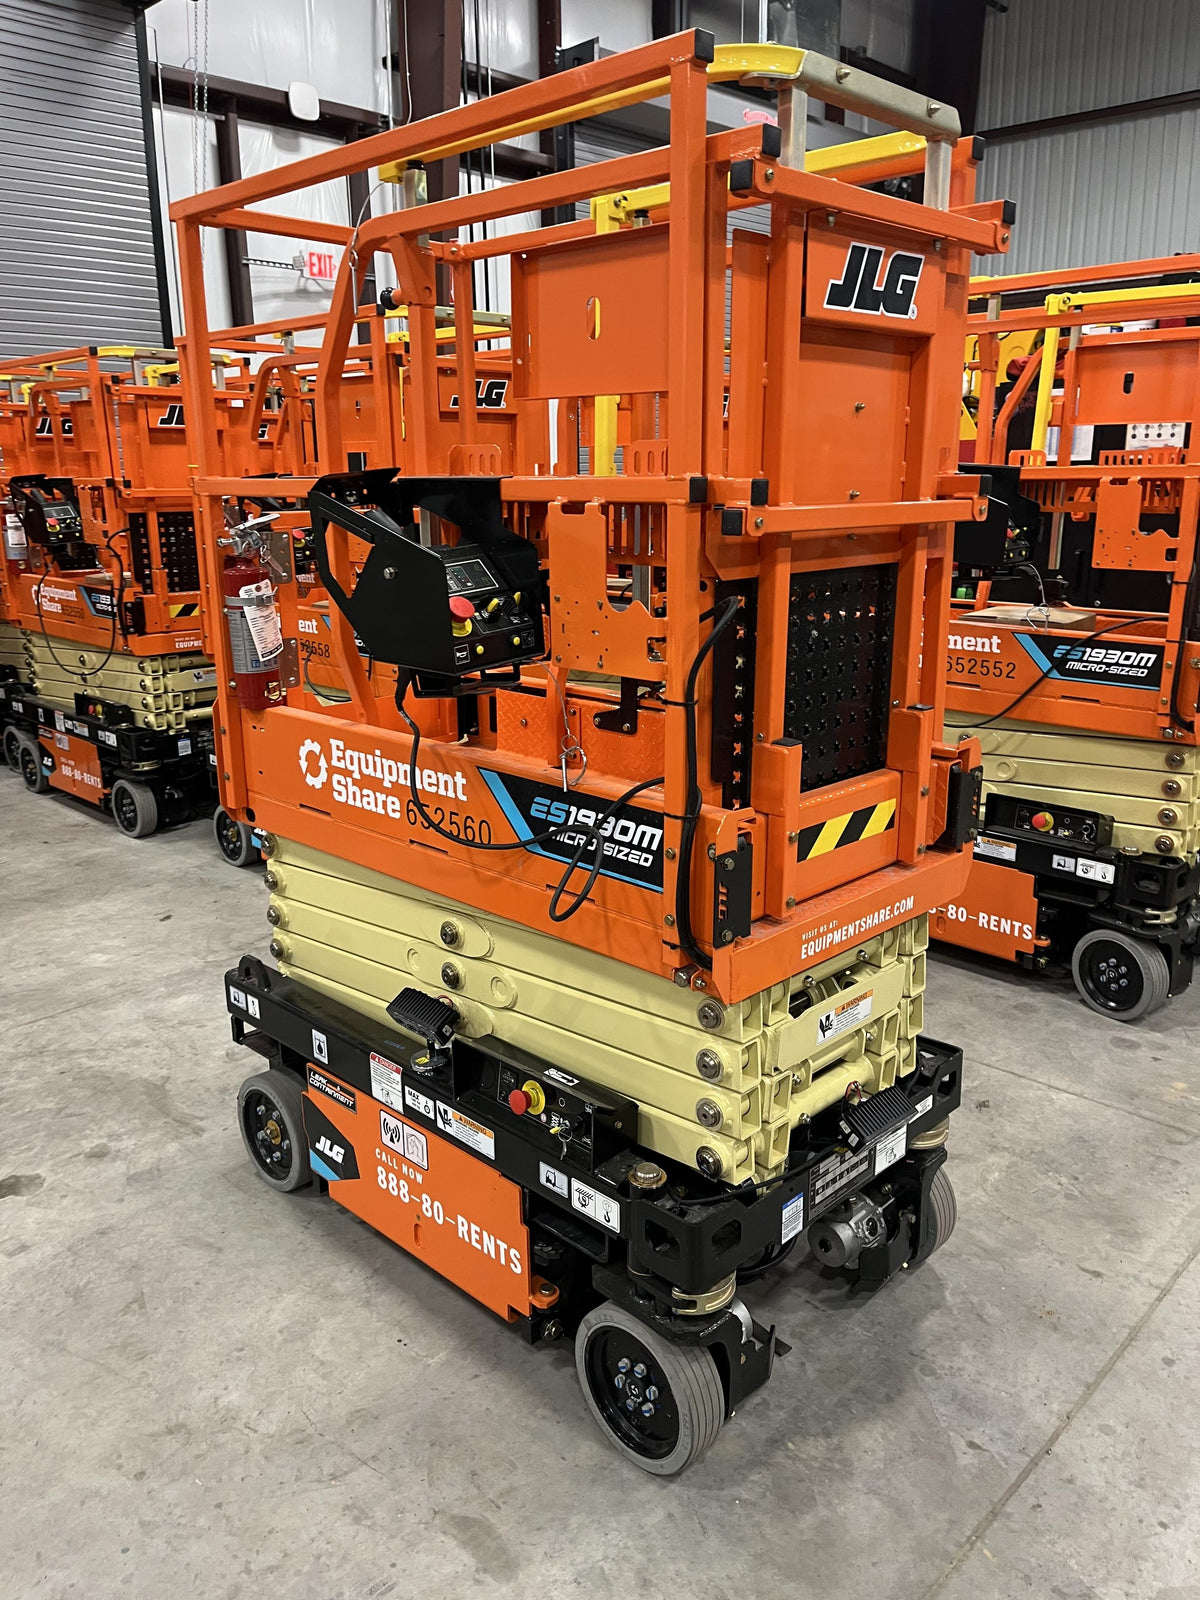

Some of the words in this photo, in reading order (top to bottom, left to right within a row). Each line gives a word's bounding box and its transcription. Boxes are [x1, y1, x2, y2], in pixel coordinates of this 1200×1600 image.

[309, 252, 333, 279] EXIT
[823, 241, 925, 318] JLG
[1053, 645, 1157, 667] ES1930M
[1065, 662, 1148, 677] MICRO-SIZED
[329, 738, 468, 802] Equipment
[332, 774, 401, 819] Share
[406, 799, 492, 845] 652560
[801, 895, 914, 960] EQUIPMENTSHARE.COM
[802, 928, 818, 941] VISIT
[819, 924, 828, 934] US
[929, 904, 1033, 940] -80-RENTS
[309, 1077, 355, 1107] CONTAINMENT
[310, 1071, 328, 1085] LEAK
[315, 1135, 345, 1164] JLG
[375, 1148, 399, 1170] CALL
[402, 1163, 423, 1184] NOW
[376, 1165, 523, 1275] 888-80-RENTS
